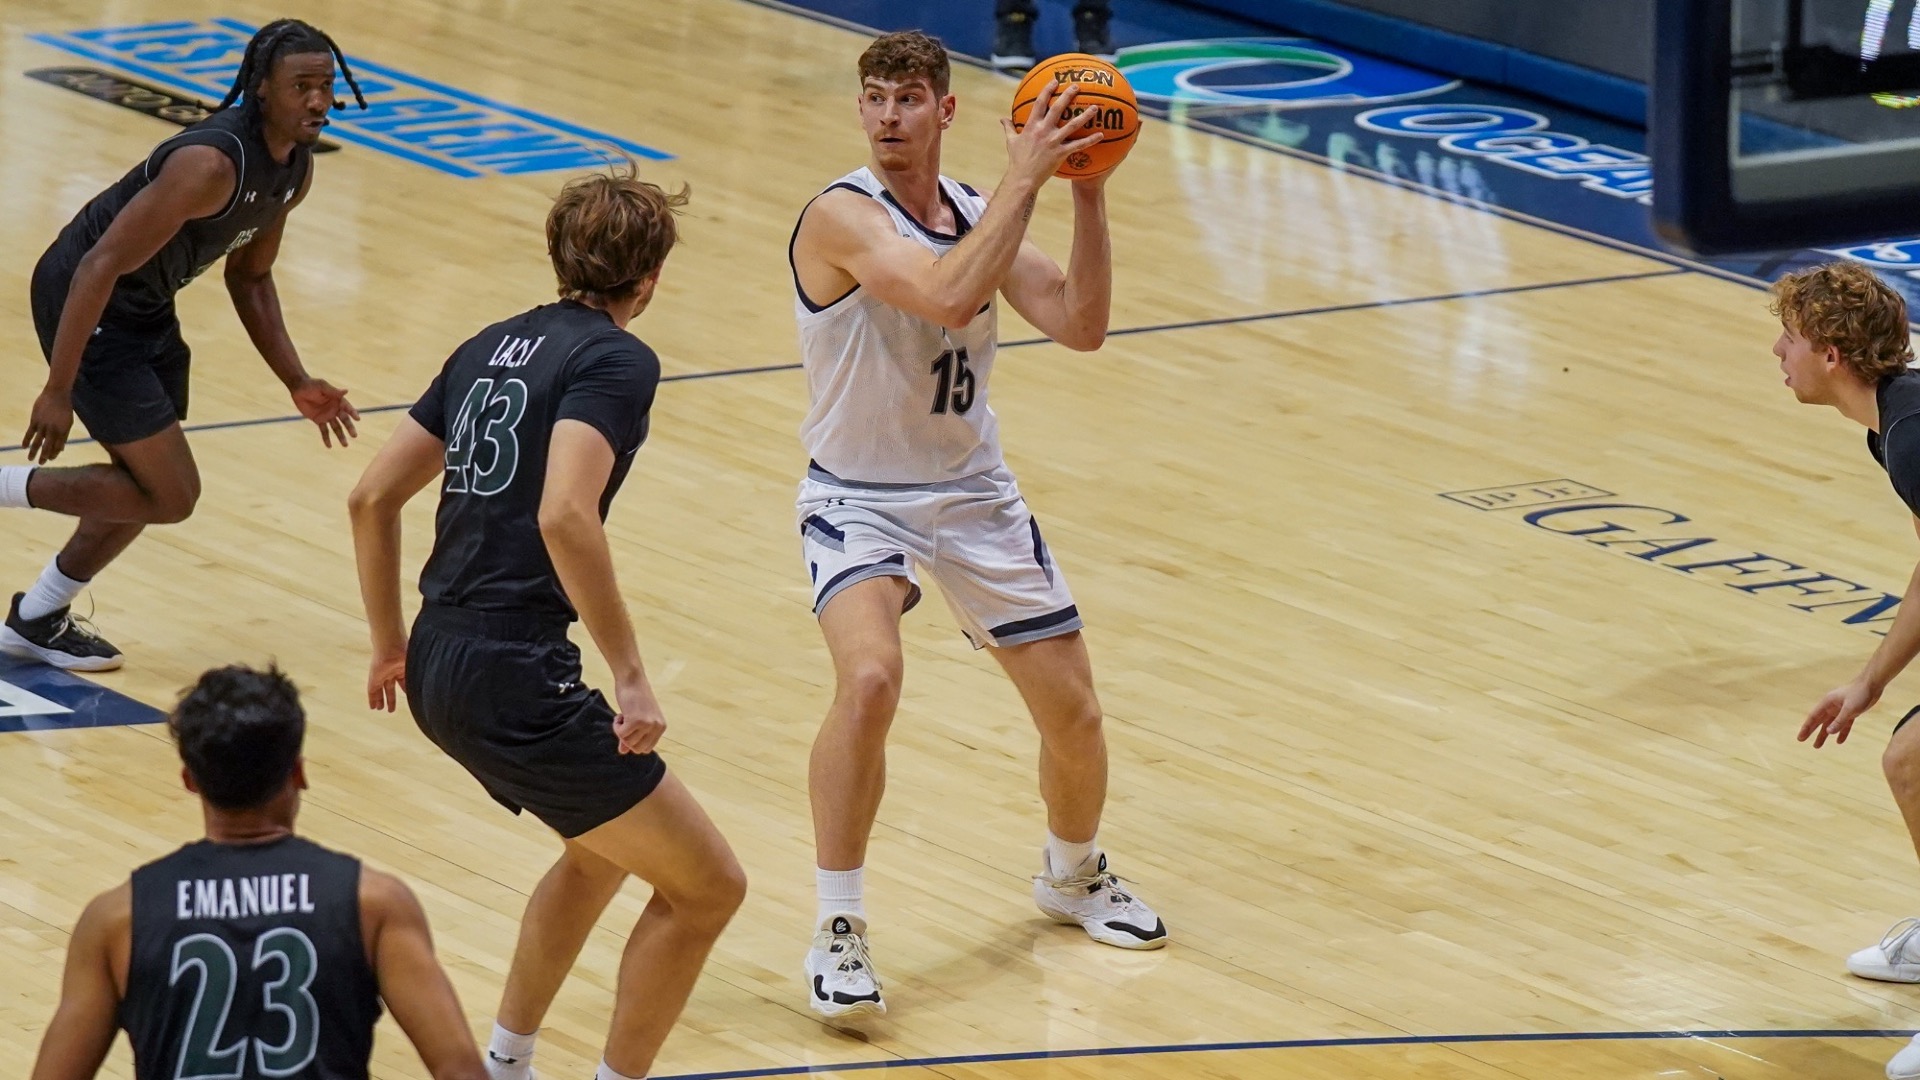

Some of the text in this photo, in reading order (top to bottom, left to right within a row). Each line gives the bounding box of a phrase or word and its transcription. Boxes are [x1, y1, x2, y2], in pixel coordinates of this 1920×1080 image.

[1055, 69, 1114, 88] NCAA
[326, 98, 630, 175] GLENN
[1354, 103, 1653, 206] OCEA
[929, 346, 976, 416] 15
[445, 378, 528, 496] 43
[1522, 503, 1905, 637] GAFFN
[176, 872, 316, 920] EMANUEL
[168, 926, 320, 1080] 23
